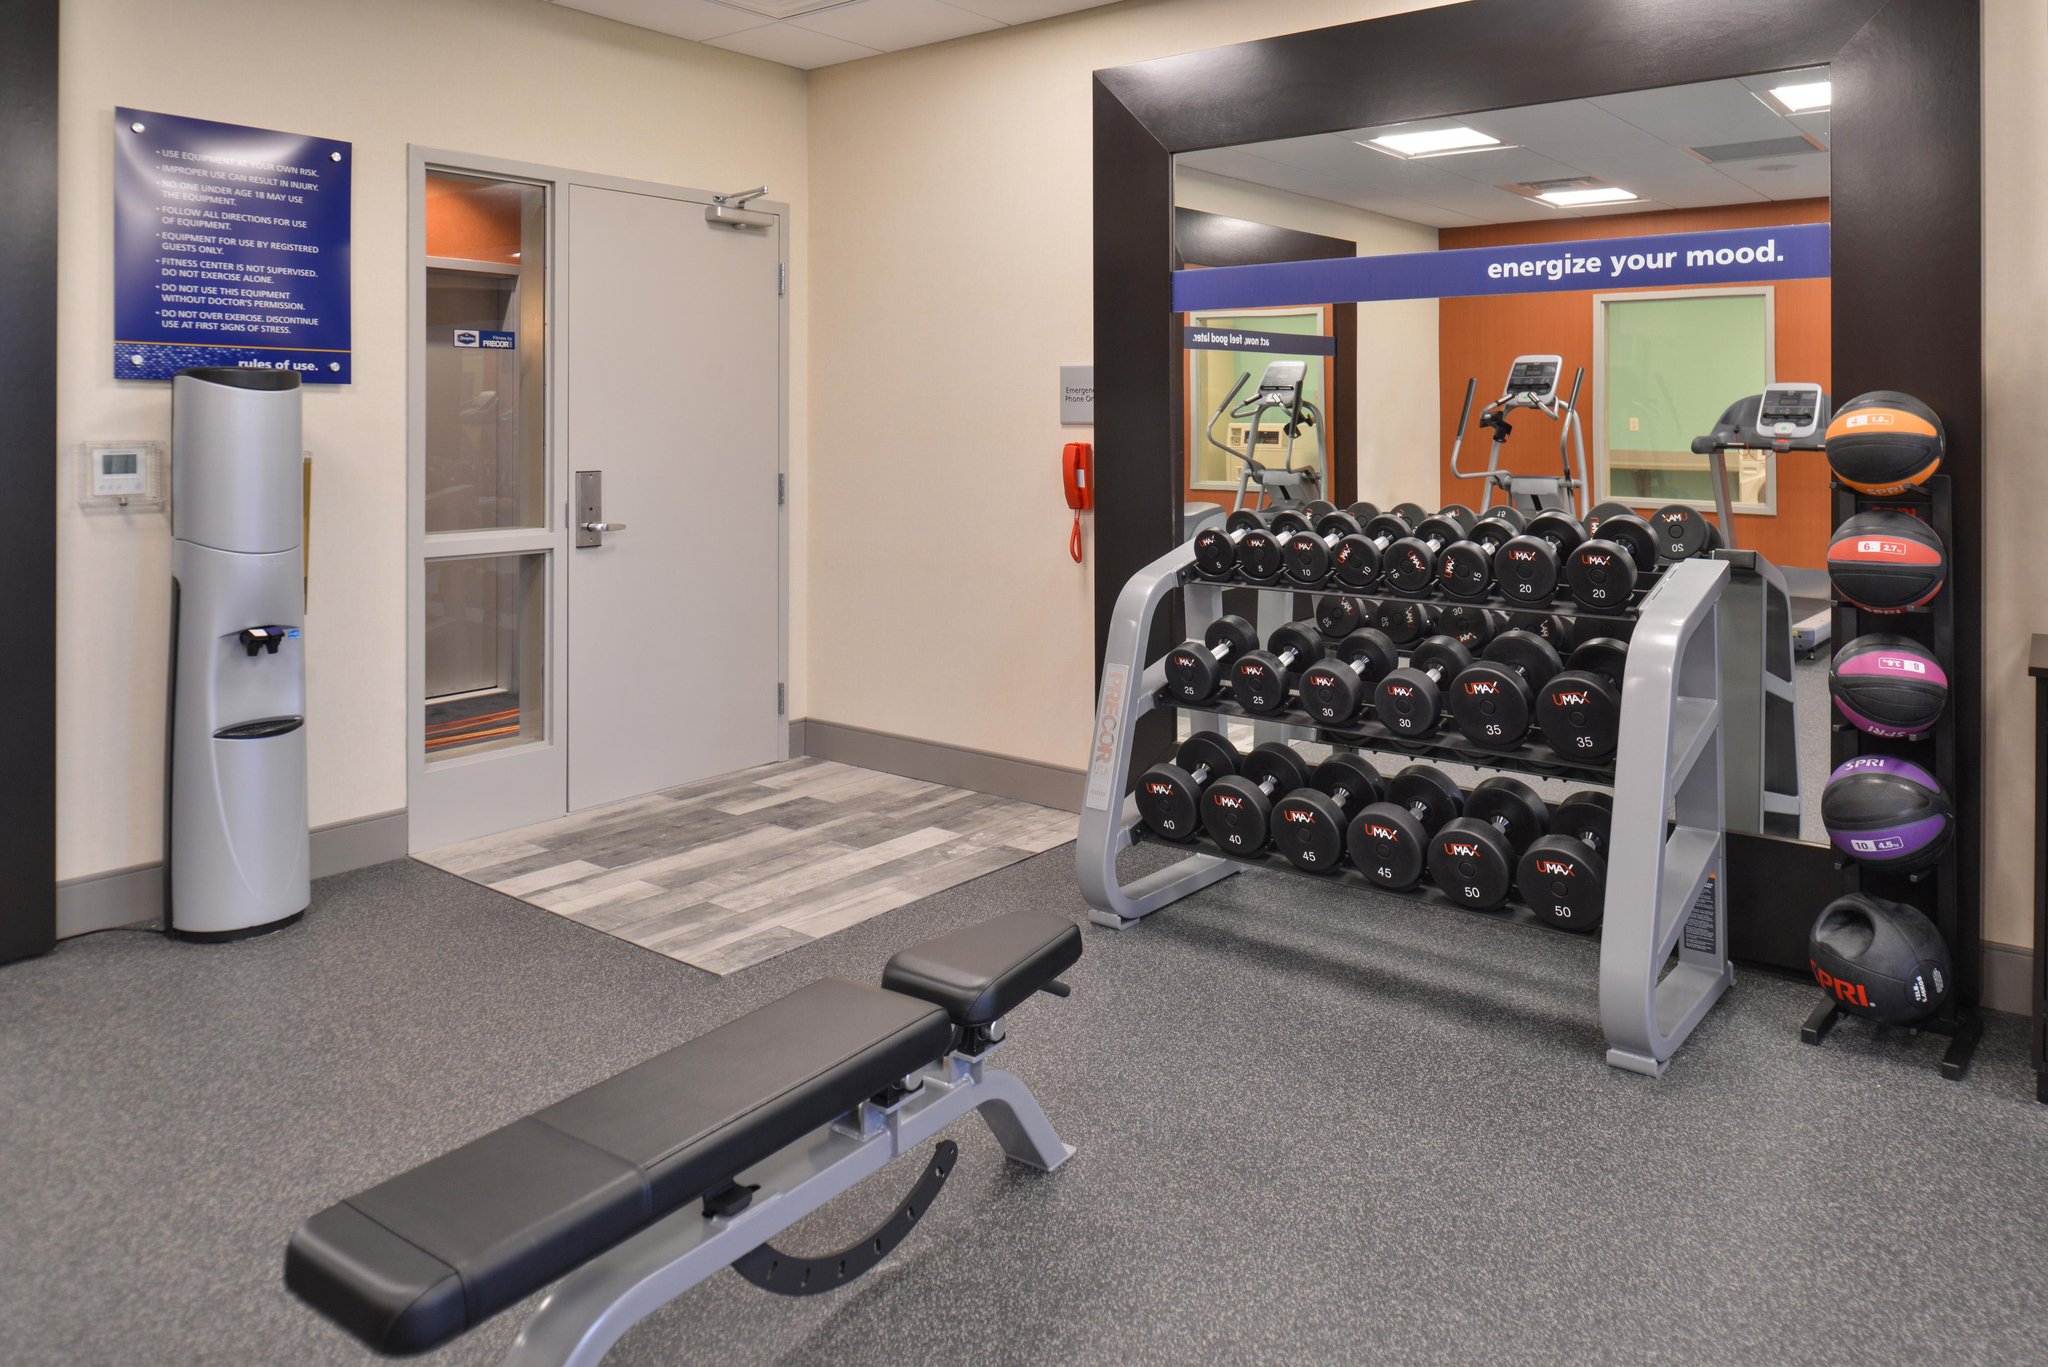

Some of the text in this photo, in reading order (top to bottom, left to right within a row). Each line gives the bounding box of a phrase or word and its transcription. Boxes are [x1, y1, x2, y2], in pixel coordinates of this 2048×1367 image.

[162, 150, 319, 177] USE EQUIPMENT AT YOUR OWN RISK.
[162, 165, 208, 176] IMPROPER
[210, 171, 226, 179] USE
[228, 173, 247, 182] CAN
[249, 176, 278, 186] RESULT
[290, 181, 319, 191] INJURY.
[162, 180, 177, 188] NO
[179, 182, 198, 191] ONE
[201, 185, 232, 195] UNDER
[234, 189, 252, 197] AGE
[267, 193, 286, 202] MAY
[162, 191, 237, 206] THE EQUIPMENT.
[162, 206, 307, 228] FOLLOW ALL DIRECTIONS FOR USE
[177, 218, 232, 230] EQUIPMENT.
[162, 231, 216, 244] EQUIPMENT
[218, 237, 236, 245] FOR
[238, 239, 254, 247] USE
[271, 242, 319, 254] REGISTERED
[162, 242, 224, 255] GUESTS ONLY.
[1487, 239, 1784, 281] energize your mood.
[162, 257, 197, 268] FITNESS
[200, 261, 234, 271] CENTER
[246, 264, 264, 273] NOT
[267, 266, 318, 277] SUPERVISED.
[162, 268, 275, 284] DO NOT EXERCISE ALONE.
[162, 283, 177, 291] DO
[179, 284, 199, 293] NOT
[219, 288, 239, 296] THIS
[241, 289, 290, 299] EQUIPMENT
[162, 294, 306, 310] WITHOUT DOCTOR'S PERMISSION.
[162, 309, 319, 326] DO NOT OVER EXERCISE. DISCONTINUE
[162, 320, 291, 334] USE AT FIRST SIGNS OF STRESS.
[238, 358, 319, 371] rules of use.
[1066, 386, 1094, 395] Emergen
[1065, 395, 1084, 403] Phone
[1293, 542, 1313, 550] UMAX
[1509, 550, 1536, 561] UMAX
[1581, 554, 1611, 566] UMAX
[1362, 566, 1371, 576] 10
[1391, 568, 1400, 579] 15
[1473, 572, 1482, 582] 15
[1519, 584, 1532, 594] 20
[1593, 589, 1606, 598] 20
[1174, 656, 1195, 667] UMAX
[1240, 665, 1264, 676] UMAX
[1310, 675, 1335, 687] UMAX
[1184, 686, 1194, 695] 25
[1388, 686, 1413, 697] UMAX
[1464, 681, 1500, 695] UMAX
[1253, 696, 1264, 705] 25
[1553, 691, 1592, 706] UMAX
[1322, 707, 1334, 717] 30
[1096, 672, 1124, 765] PRECOR
[1399, 718, 1411, 728] 30
[1486, 724, 1501, 736] 35
[1867, 726, 1906, 737] SPRI
[1576, 736, 1593, 748] 35
[1845, 759, 1885, 771] SPRI
[1145, 783, 1174, 796] UMAX
[1214, 795, 1244, 810] UMAX
[1284, 810, 1316, 824] UMAX
[1163, 820, 1175, 830] 40
[1364, 823, 1398, 842] UMAX
[1229, 835, 1242, 845] 40
[1855, 842, 1869, 850] 10
[1443, 843, 1480, 857] UMAX
[1302, 851, 1316, 862] 45
[1377, 867, 1392, 878] 45
[1536, 860, 1575, 877] UMAX
[1464, 886, 1480, 898] 50
[1555, 905, 1571, 918] 50
